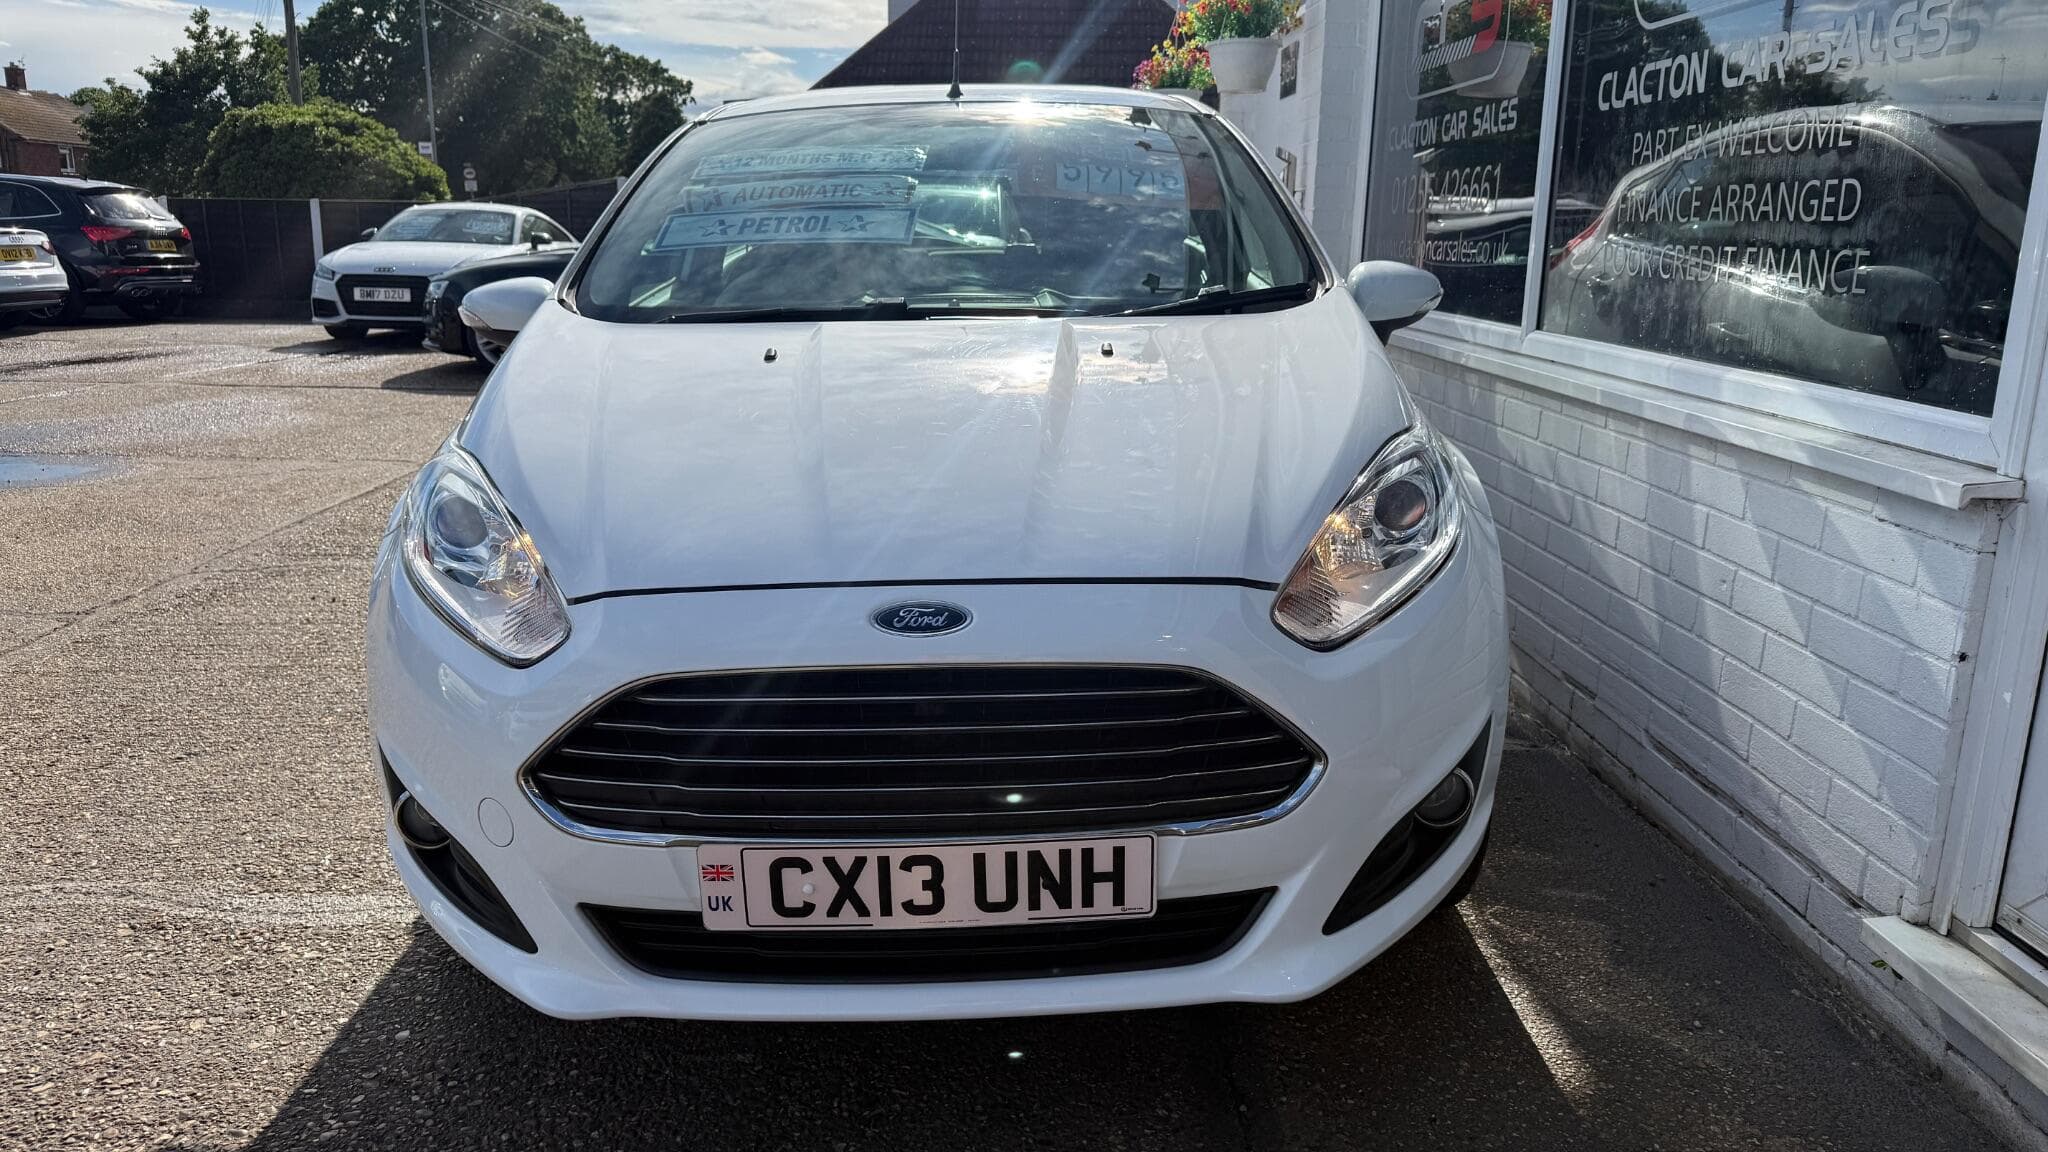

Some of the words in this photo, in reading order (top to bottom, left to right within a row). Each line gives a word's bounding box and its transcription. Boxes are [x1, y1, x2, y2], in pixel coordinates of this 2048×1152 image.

[1599, 49, 1709, 111] CLACTON
[1722, 31, 1790, 88] CAR
[1806, 0, 1952, 74] SALES
[1388, 116, 1438, 151] CLACTON
[1441, 110, 1467, 143] CAR
[1472, 97, 1518, 138] SALES
[1631, 127, 1679, 166] PART
[1684, 122, 1711, 161] EX
[1718, 102, 1858, 159] WELCOME
[759, 152, 832, 167] MONTHS
[732, 183, 865, 206] AUTOMATIC
[1440, 163, 1502, 213] 426661
[1617, 185, 1703, 224] FINANCE
[1708, 178, 1862, 222] ARRANGED
[736, 215, 833, 236] PETROL
[1602, 247, 1652, 278] POOR
[1659, 245, 1738, 283] CREDIT
[1744, 246, 1871, 294] FINANCE
[893, 608, 949, 628] Ford
[708, 896, 734, 912] UK
[768, 854, 946, 919] CX13
[973, 846, 1126, 914] UNH
